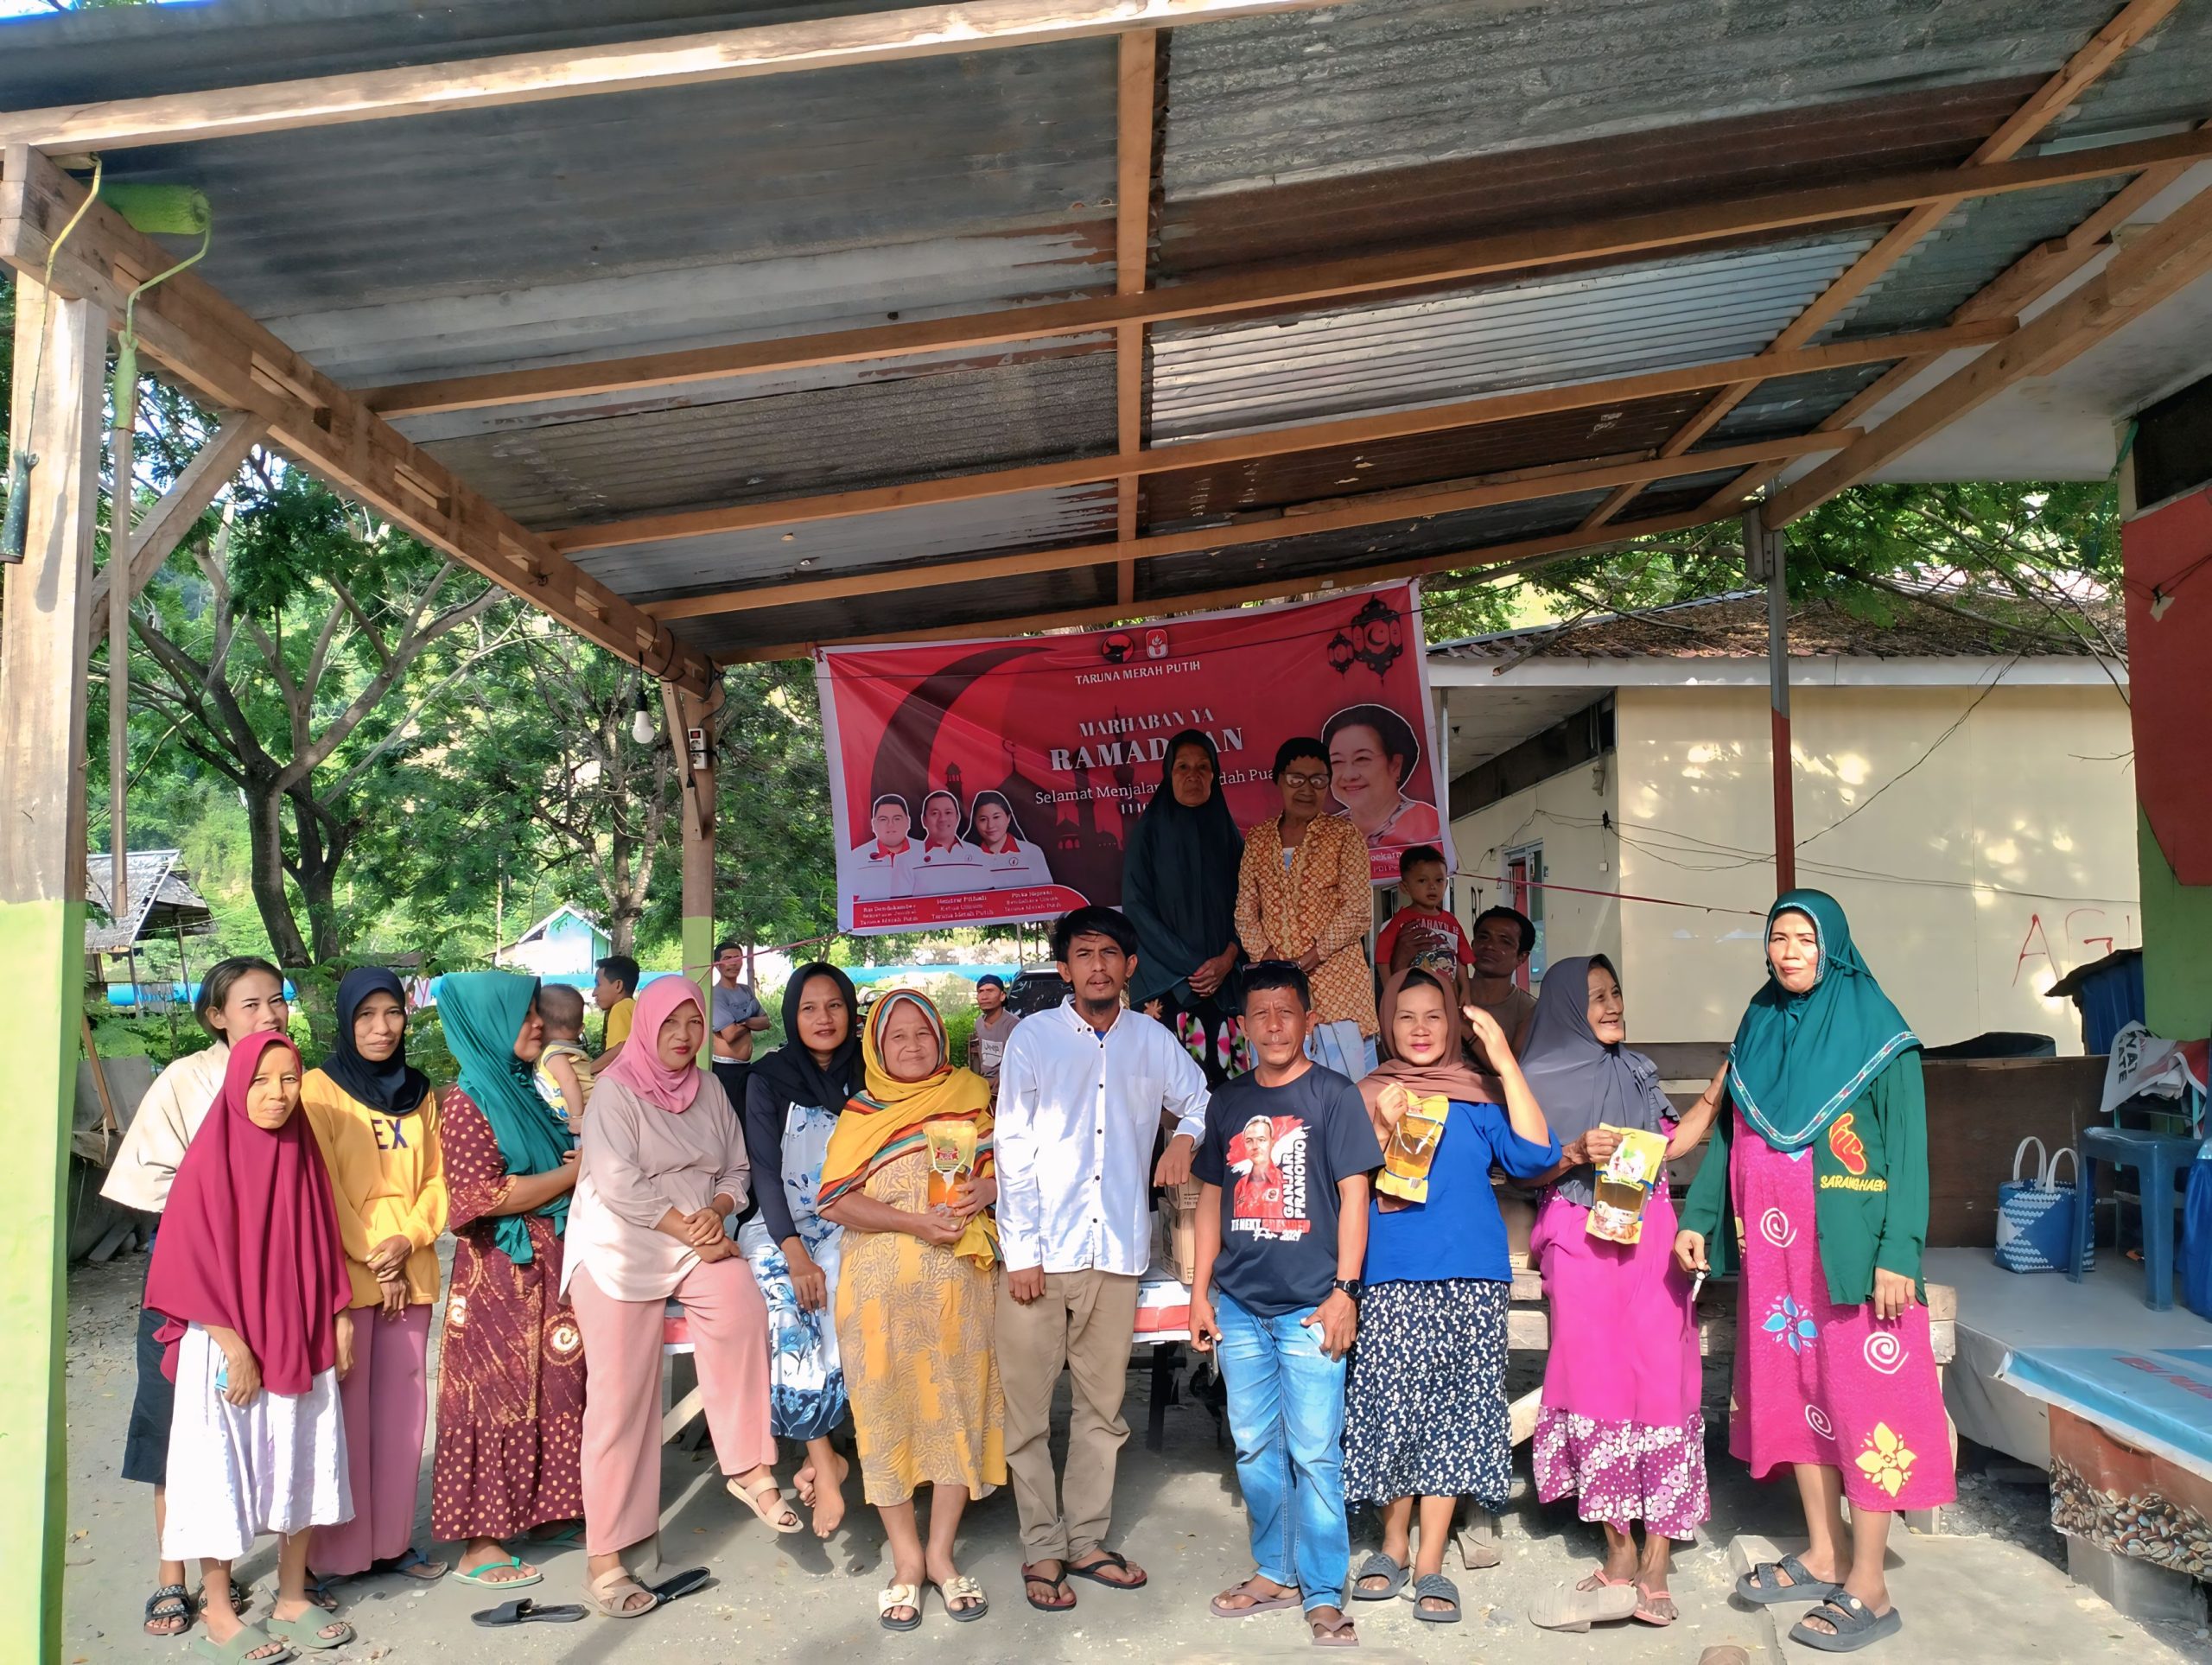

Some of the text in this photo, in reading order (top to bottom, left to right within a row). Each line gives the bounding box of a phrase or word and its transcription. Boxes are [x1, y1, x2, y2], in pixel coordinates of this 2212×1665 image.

[1075, 661, 1200, 685] TARUNA MERAH PUTIH
[1079, 708, 1214, 737] MARHABAN YA
[1050, 728, 1243, 771] RAMADAN
[1035, 787, 1093, 804] Selamat
[1219, 770, 1245, 785] dah
[1249, 769, 1274, 781] Pua
[1282, 1153, 1294, 1218] GANJAR
[1294, 1140, 1306, 1218] PRANOWO
